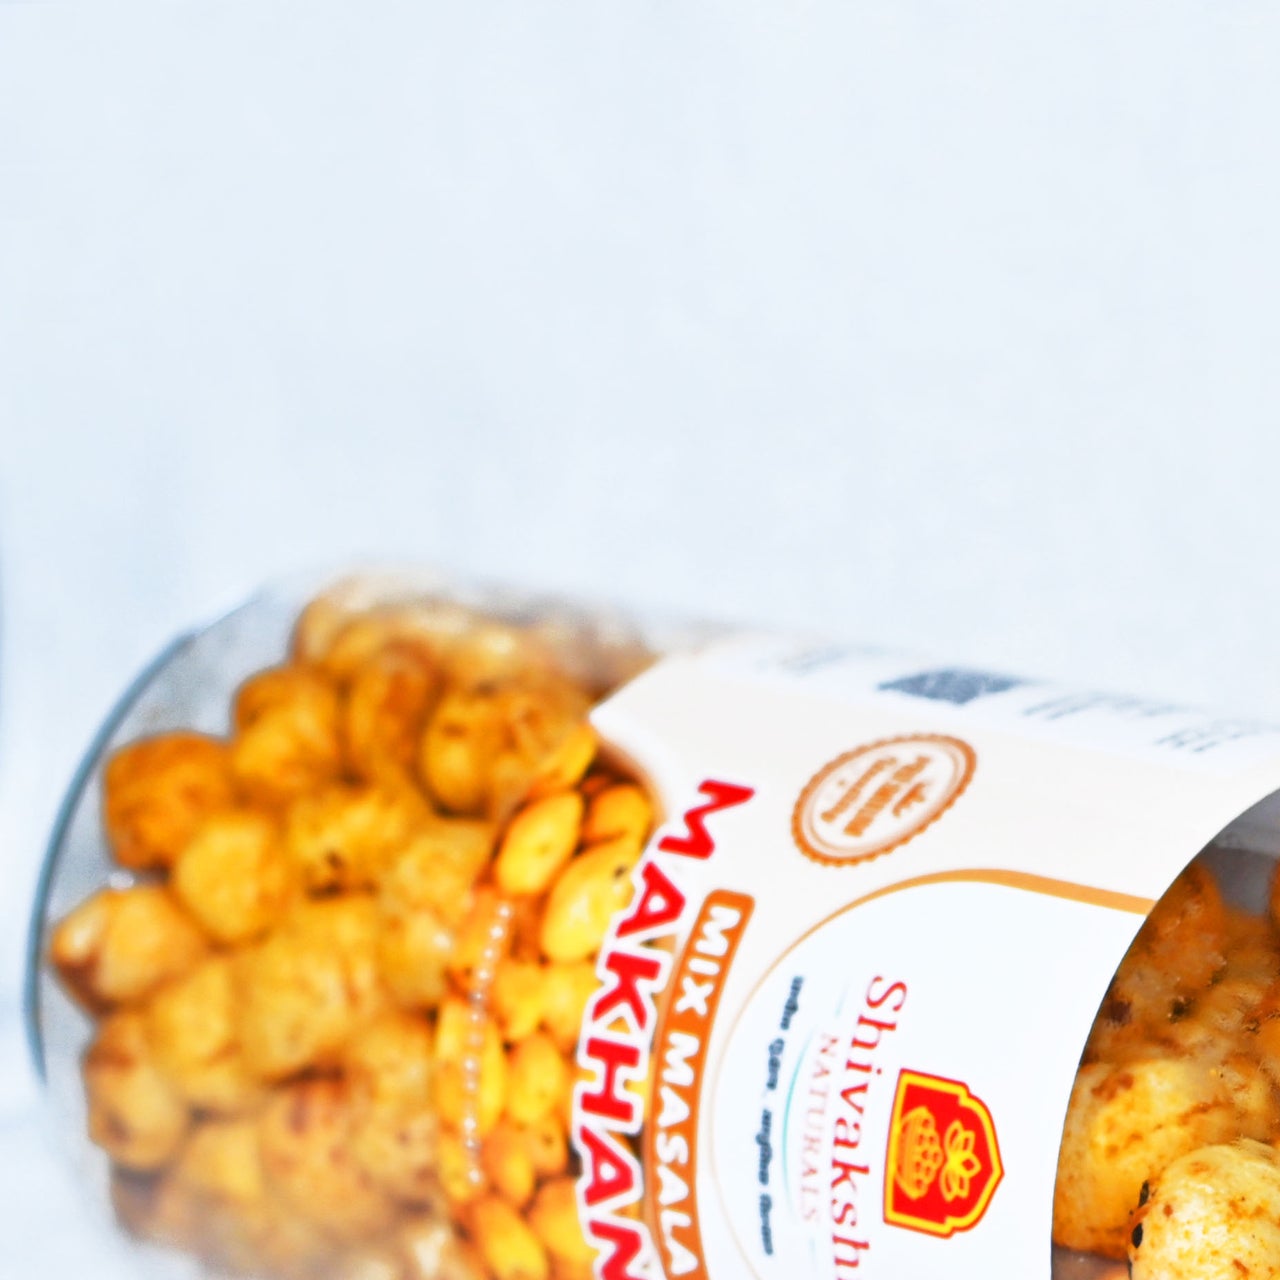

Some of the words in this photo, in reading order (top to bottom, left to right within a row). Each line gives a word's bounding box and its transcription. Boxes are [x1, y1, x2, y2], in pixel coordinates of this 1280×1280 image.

[675, 904, 743, 1017] MIX
[655, 1031, 701, 1277] MASALA
[800, 1031, 840, 1224] NATURALS
